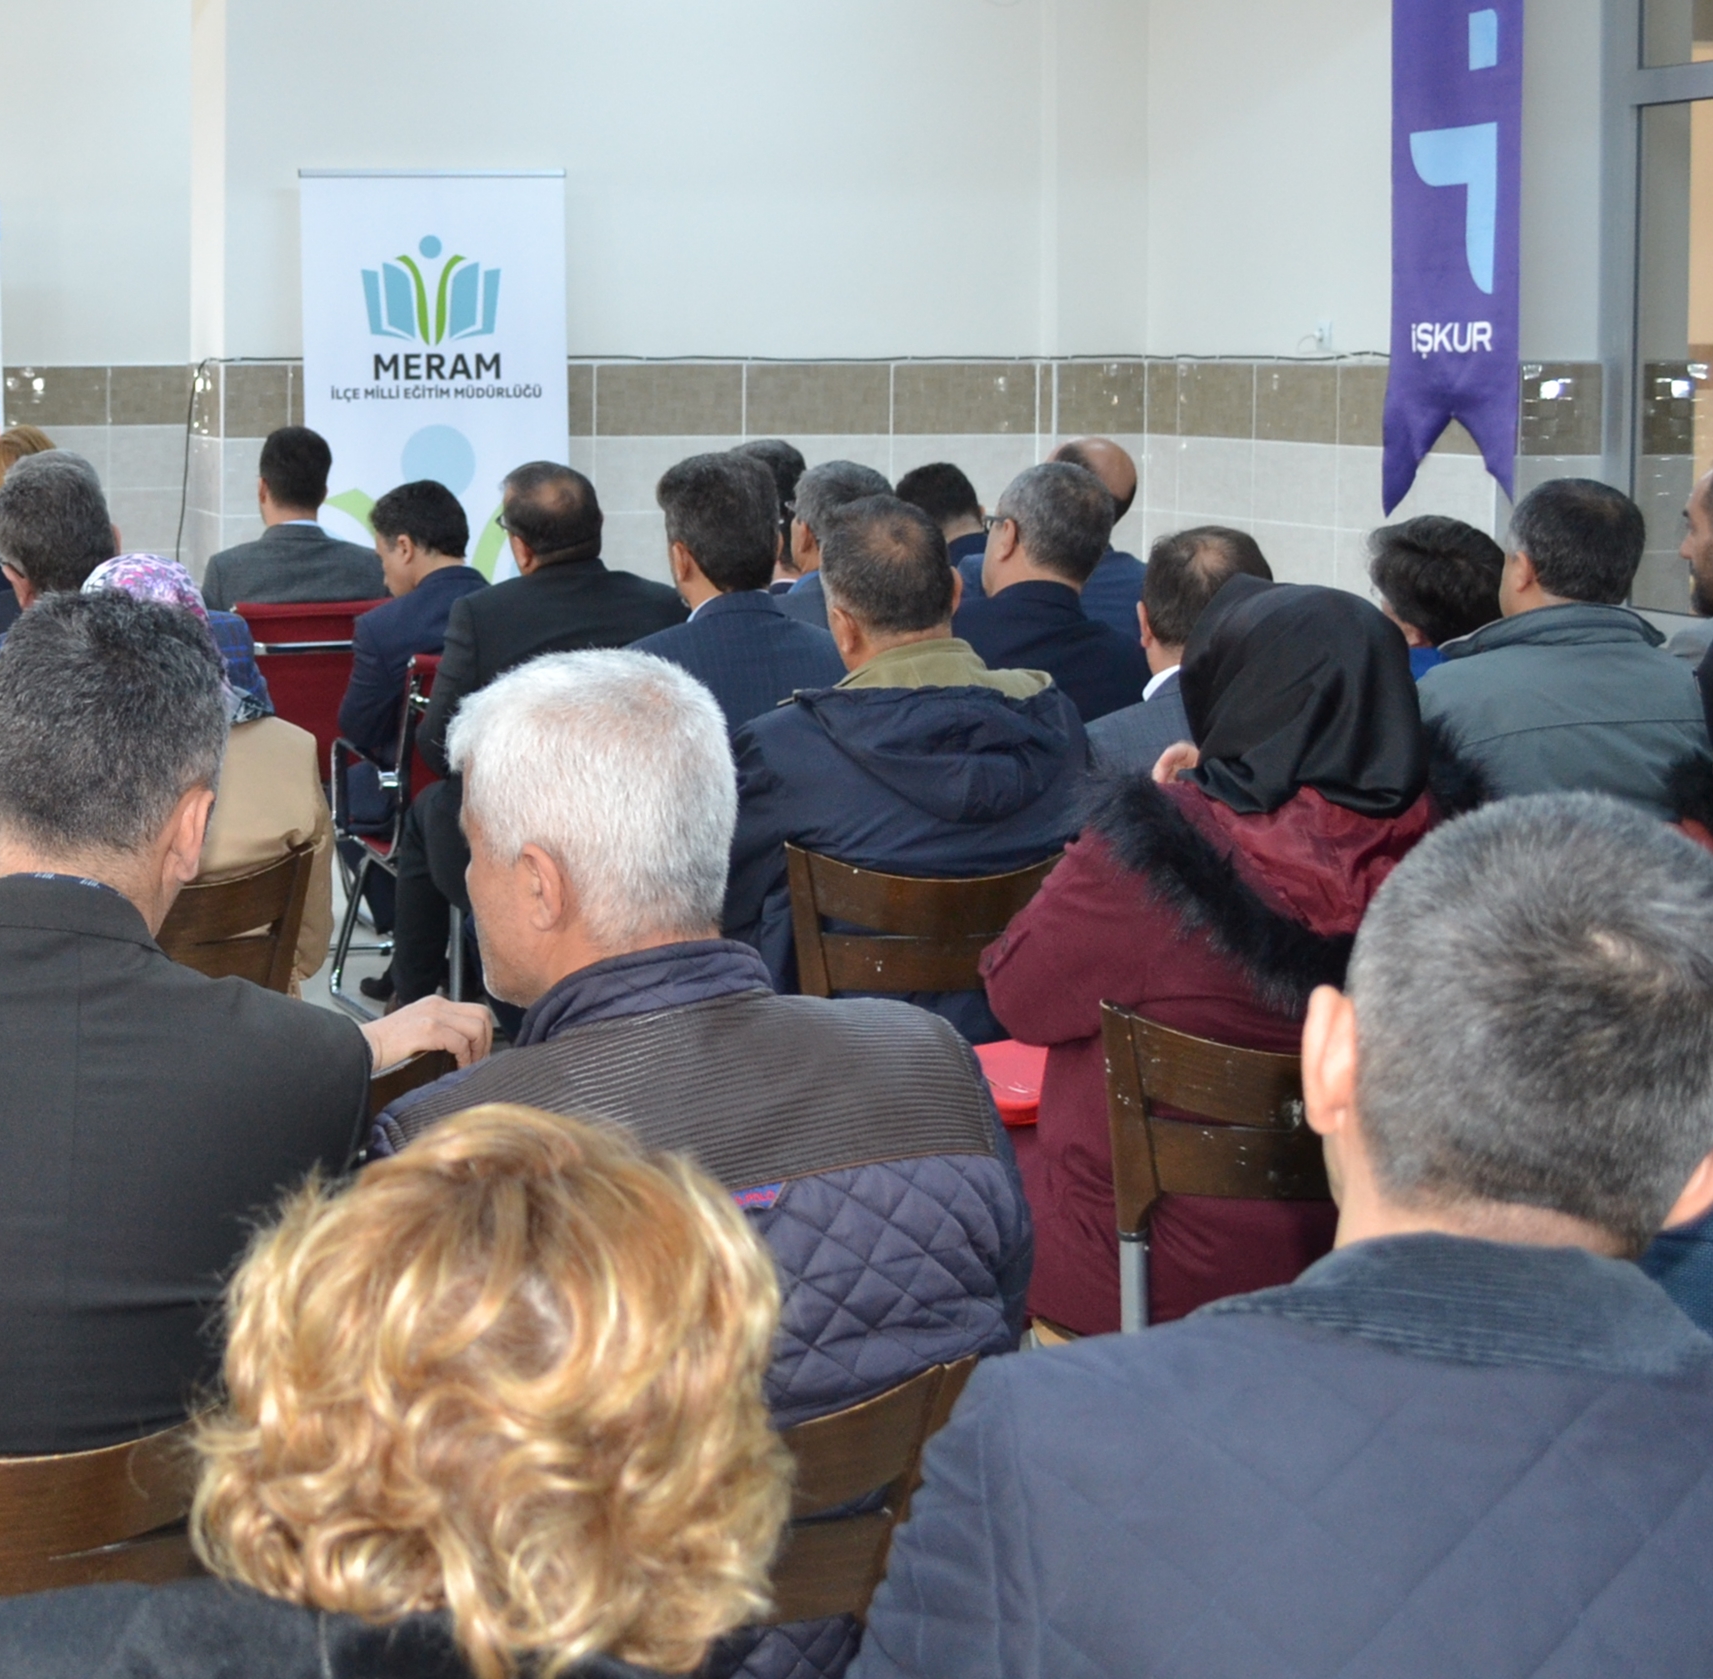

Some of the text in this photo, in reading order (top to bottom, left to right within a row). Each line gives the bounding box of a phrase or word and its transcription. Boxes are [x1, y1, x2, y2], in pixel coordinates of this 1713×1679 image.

[373, 352, 501, 381] MERAM
[331, 383, 542, 402] İLÇE MİLLİ EĞİTİM MÜDÜRLÜĞÜ
